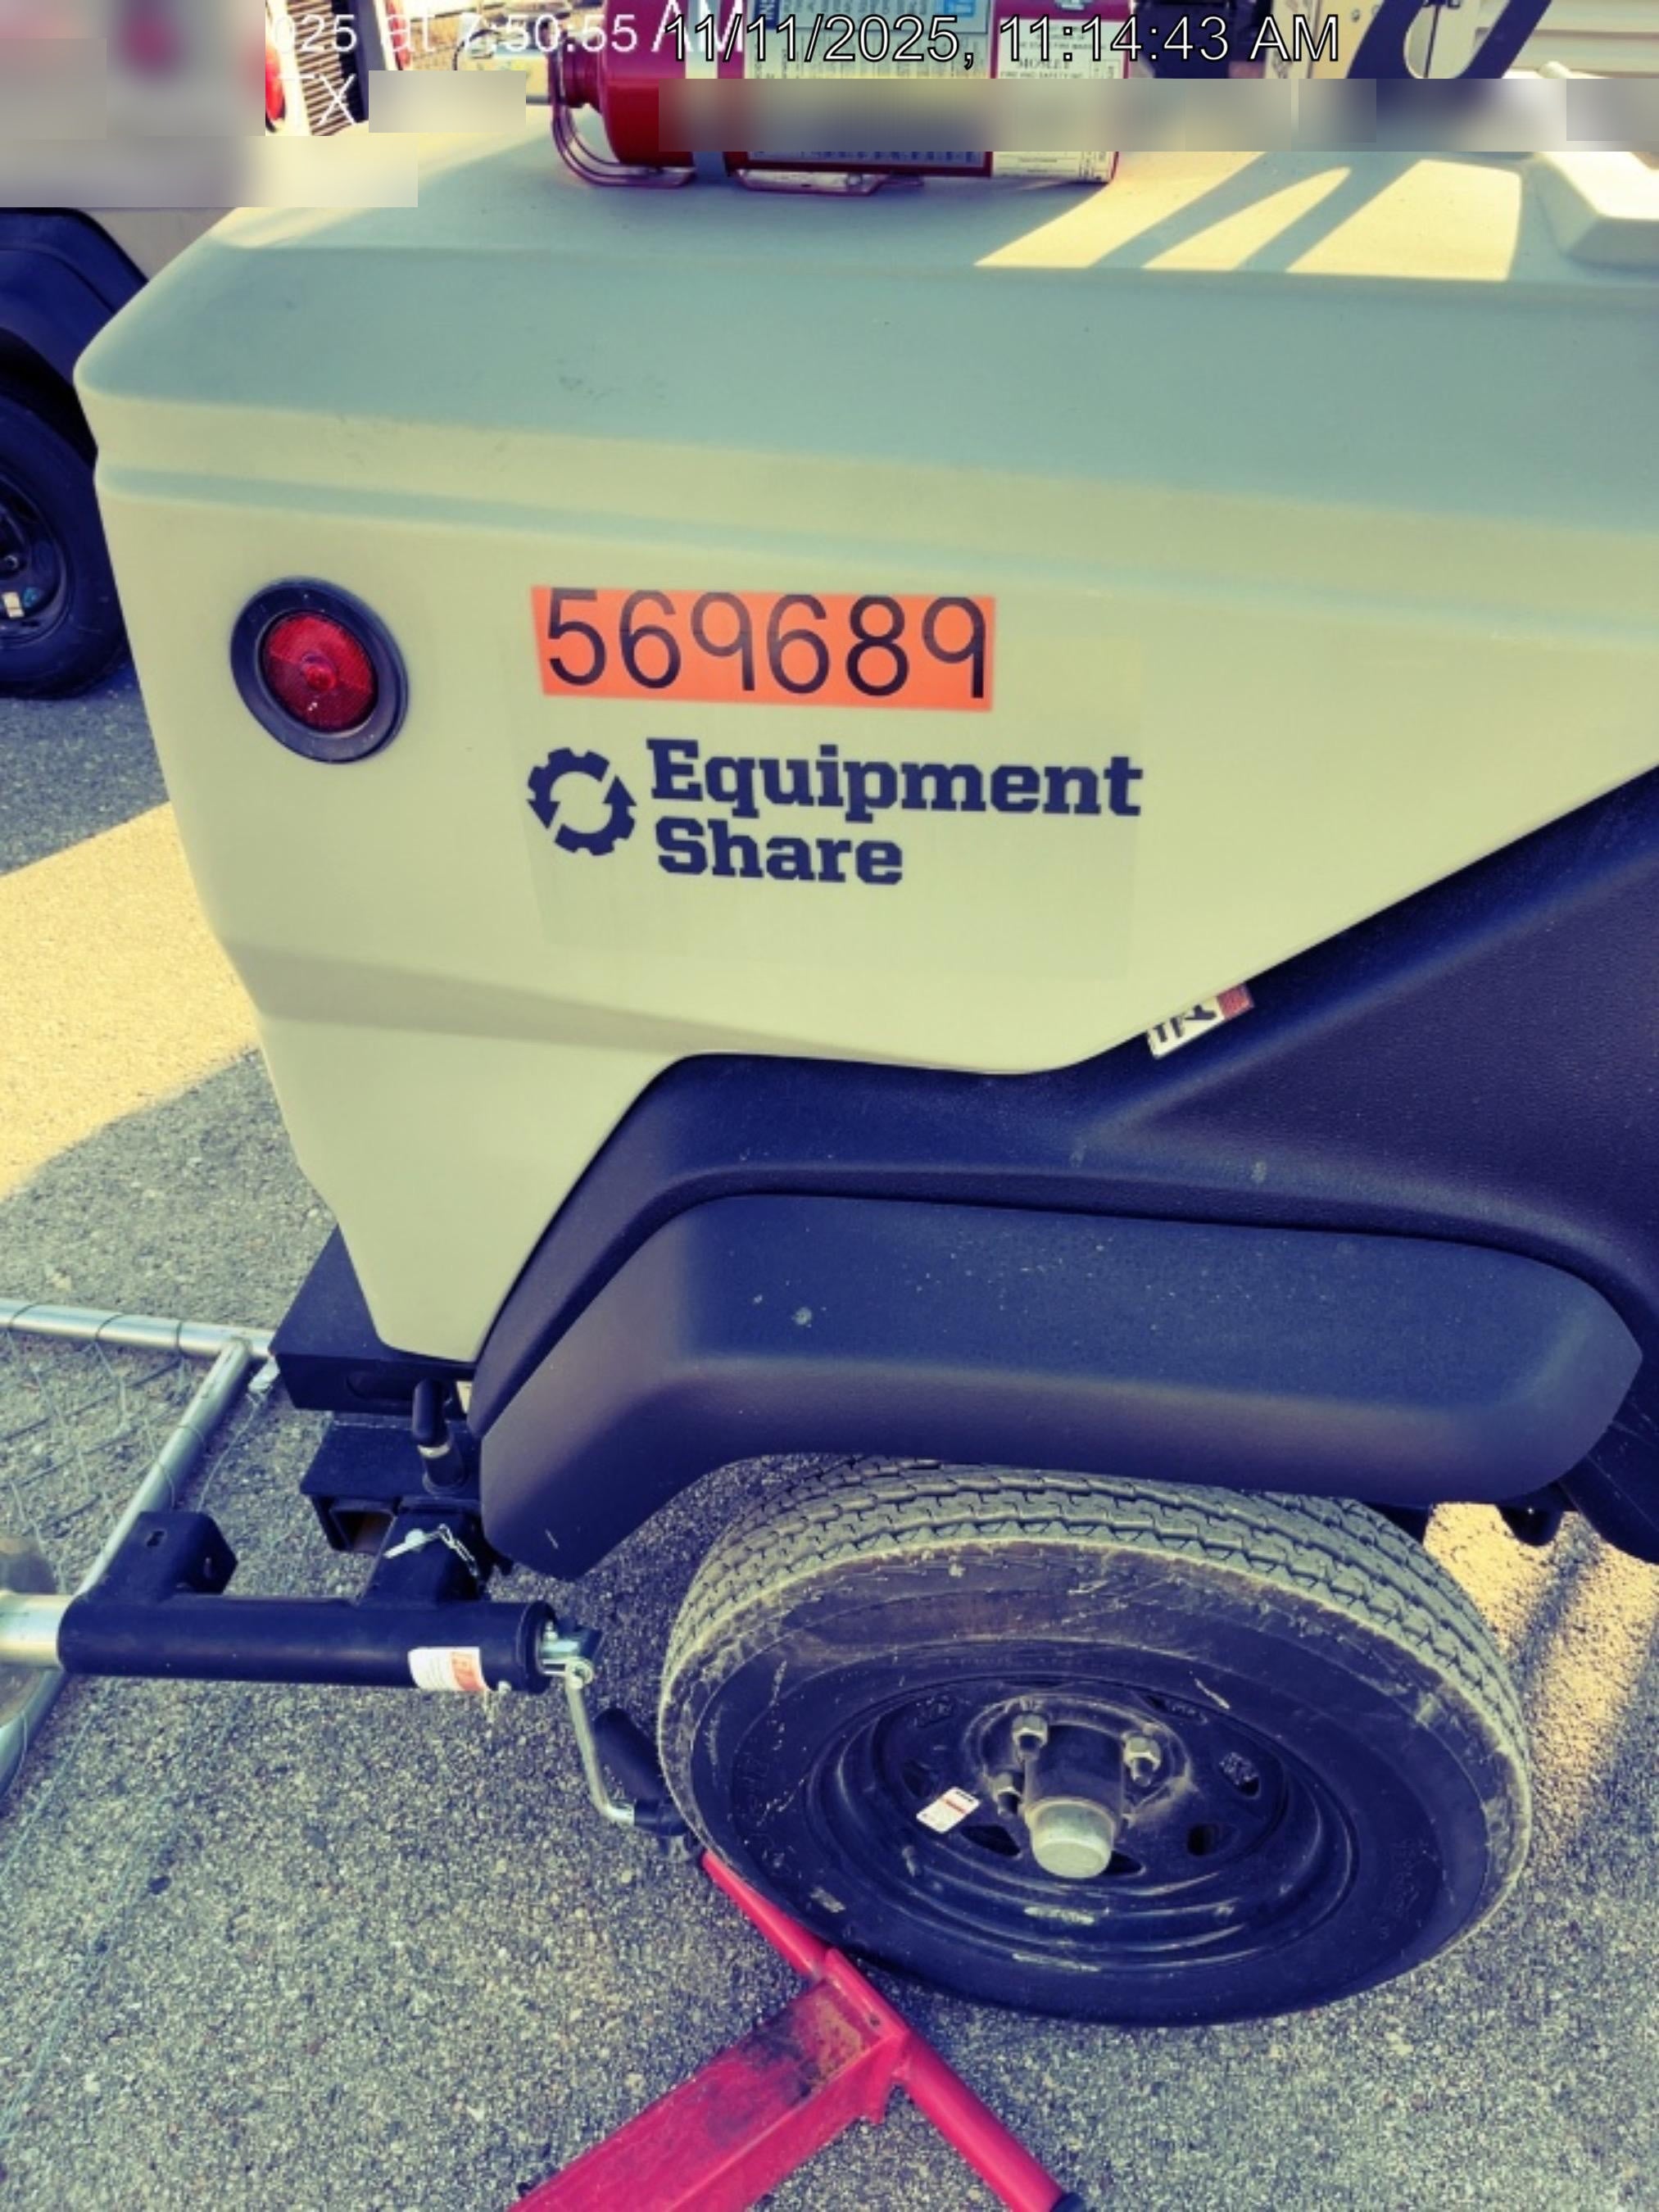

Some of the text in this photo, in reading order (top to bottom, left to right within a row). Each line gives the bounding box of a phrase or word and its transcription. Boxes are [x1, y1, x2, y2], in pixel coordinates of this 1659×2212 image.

[546, 587, 987, 700] 569689
[646, 737, 1144, 824] Equipment
[655, 814, 904, 886] Share
